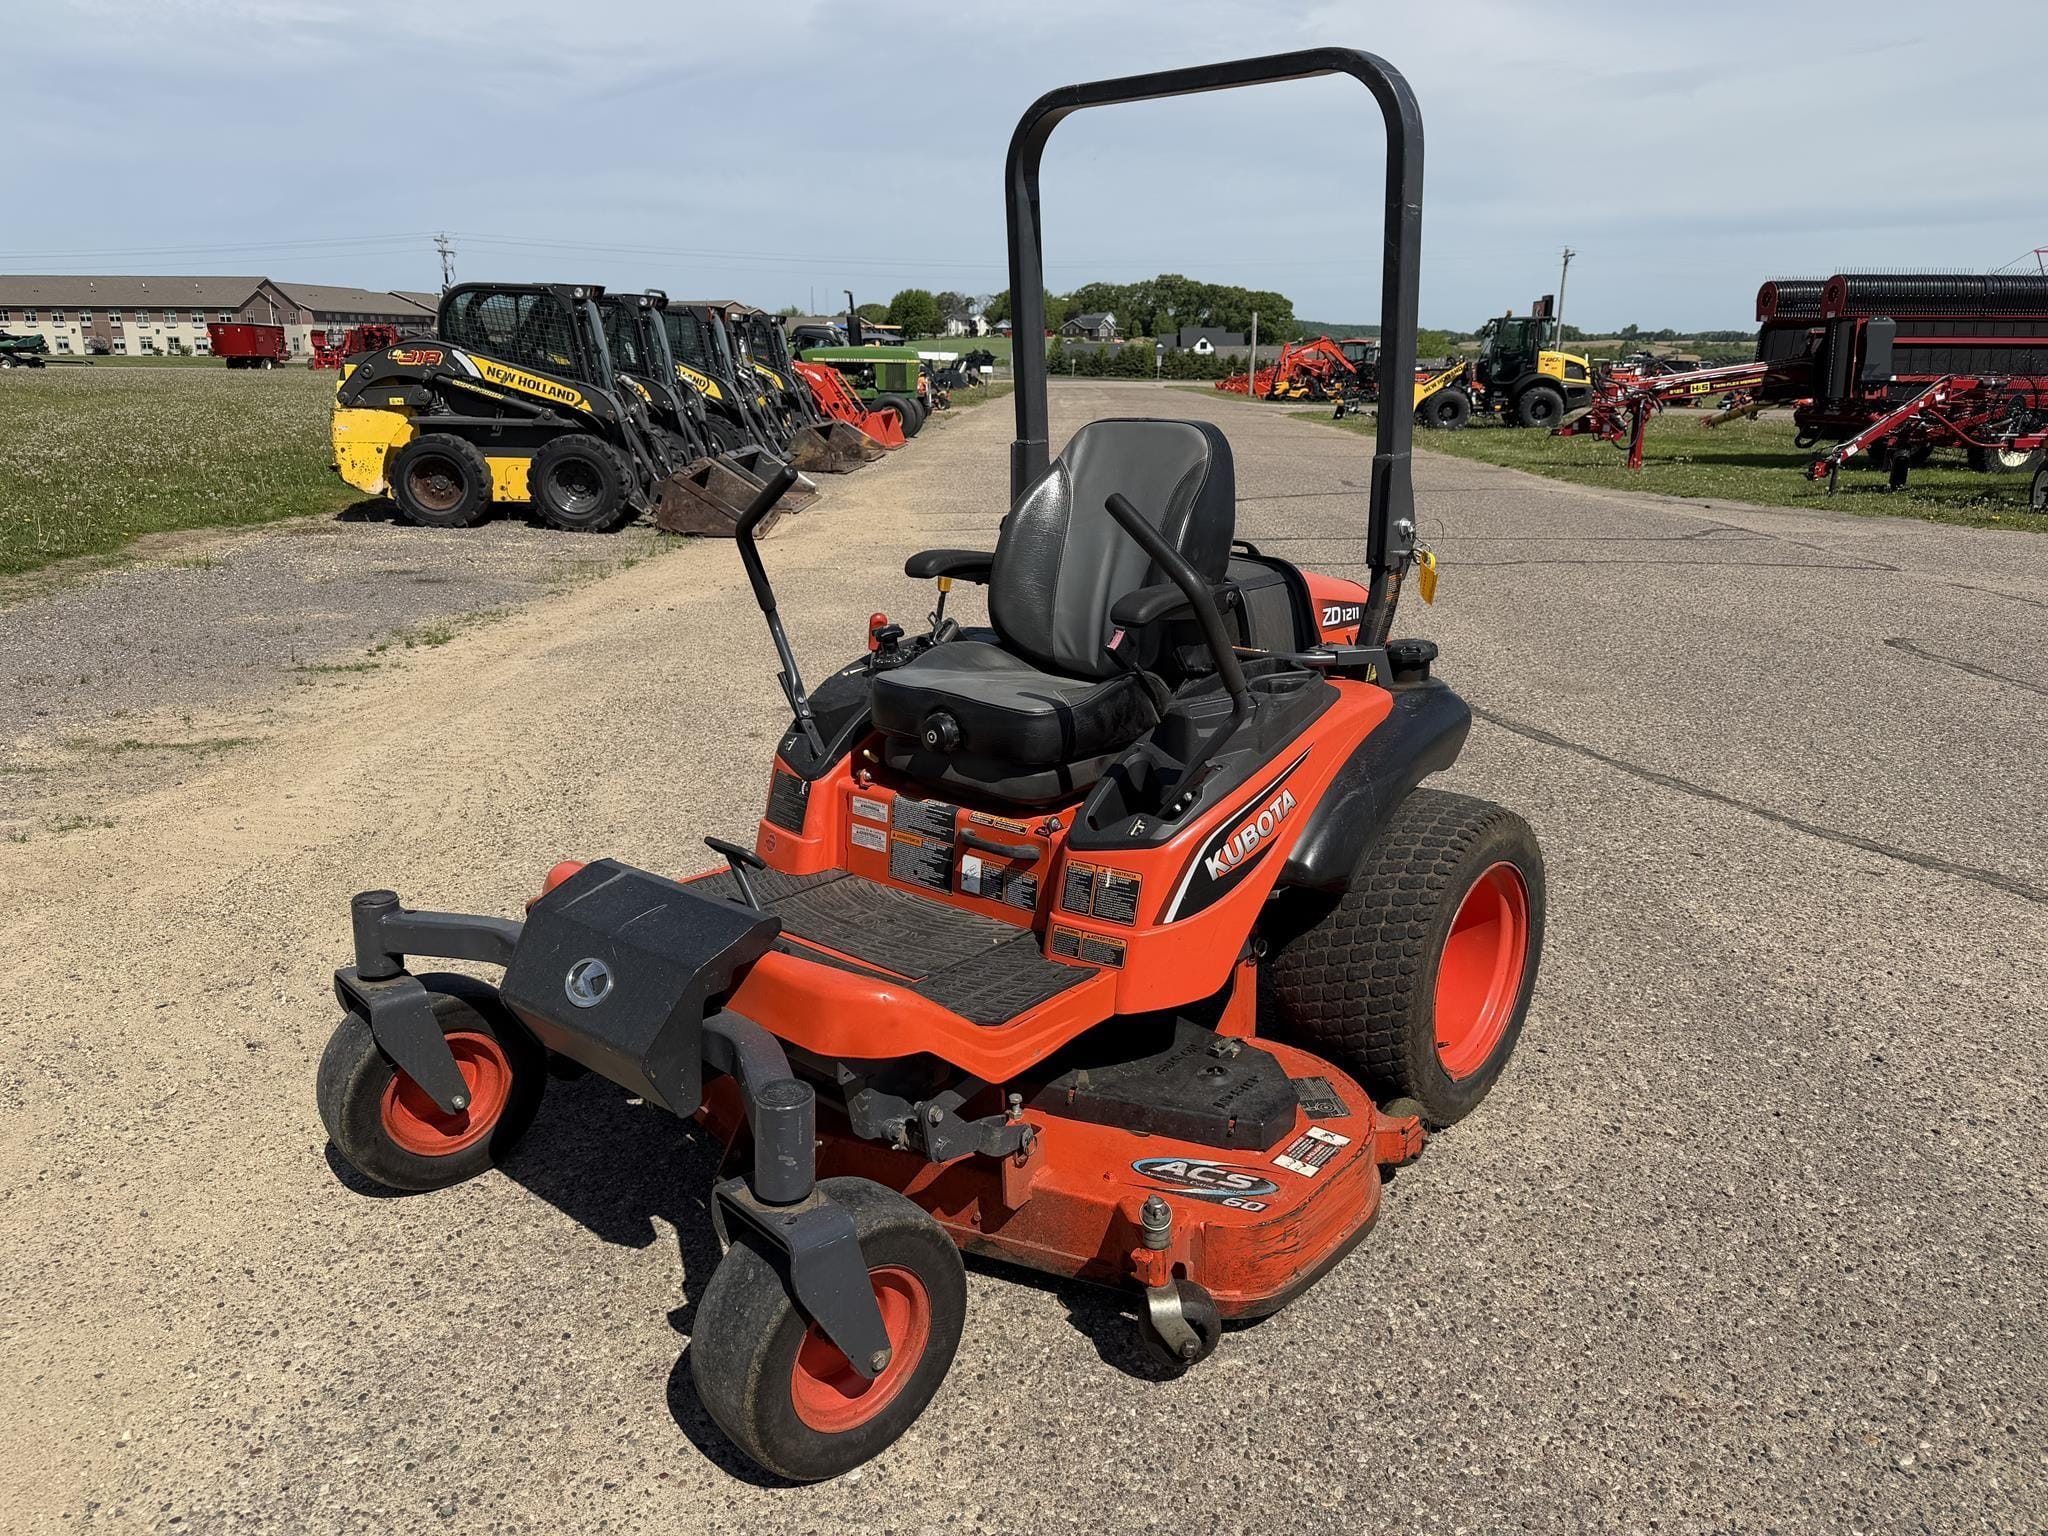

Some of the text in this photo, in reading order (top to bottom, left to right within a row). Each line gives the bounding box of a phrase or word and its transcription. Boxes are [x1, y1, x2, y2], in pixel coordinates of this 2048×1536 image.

[486, 366, 575, 402] NEW HOLLAND
[1204, 788, 1298, 882] KUBOTA
[1150, 1160, 1260, 1190] ACS
[1222, 1197, 1268, 1212] 60
